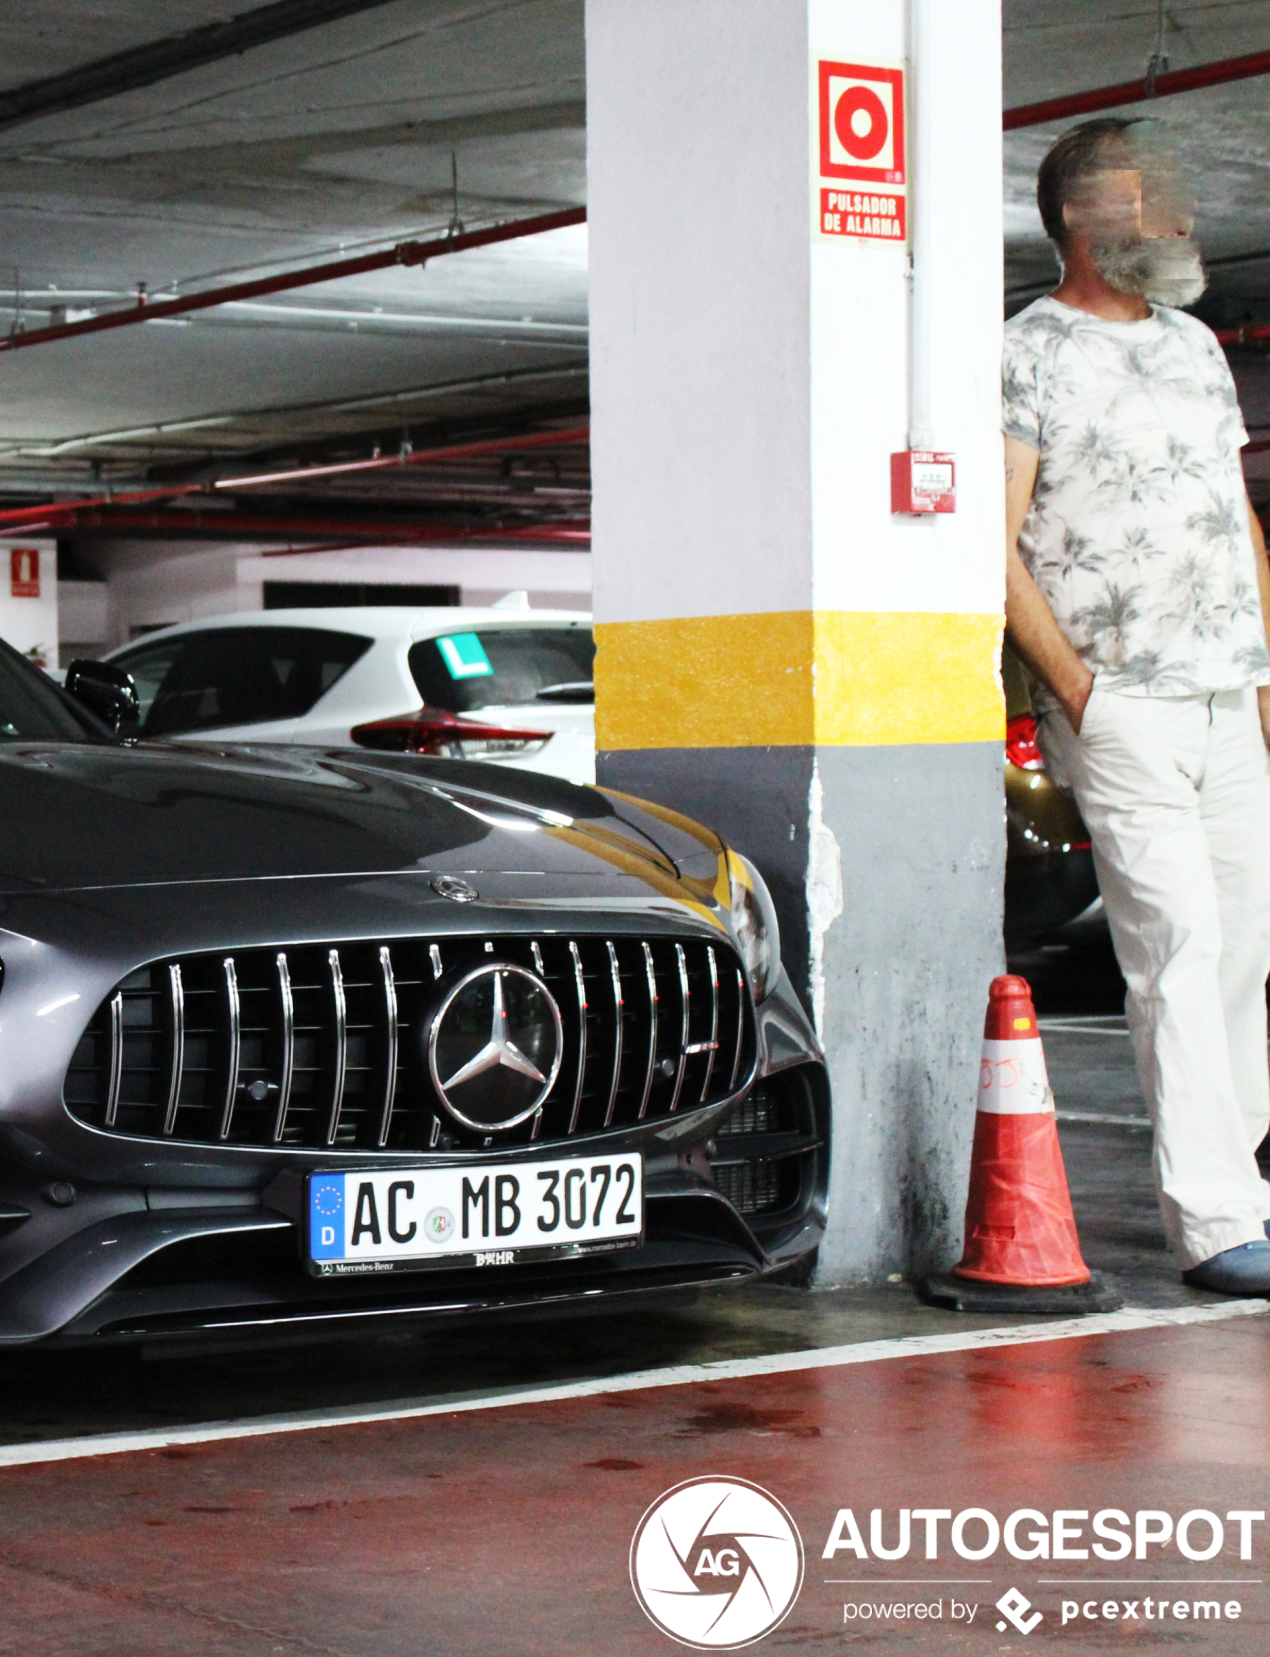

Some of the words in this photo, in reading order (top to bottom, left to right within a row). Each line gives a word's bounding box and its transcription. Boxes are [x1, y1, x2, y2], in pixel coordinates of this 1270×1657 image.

[828, 192, 896, 216] PULSADOR
[824, 213, 841, 232] DE
[846, 215, 901, 237] ALARMA
[441, 638, 489, 676] L
[351, 1180, 417, 1246] AC
[461, 1174, 522, 1239] MB
[536, 1163, 636, 1232] 3072
[321, 1226, 335, 1245] D
[336, 1262, 394, 1273] Mercedes-Benz
